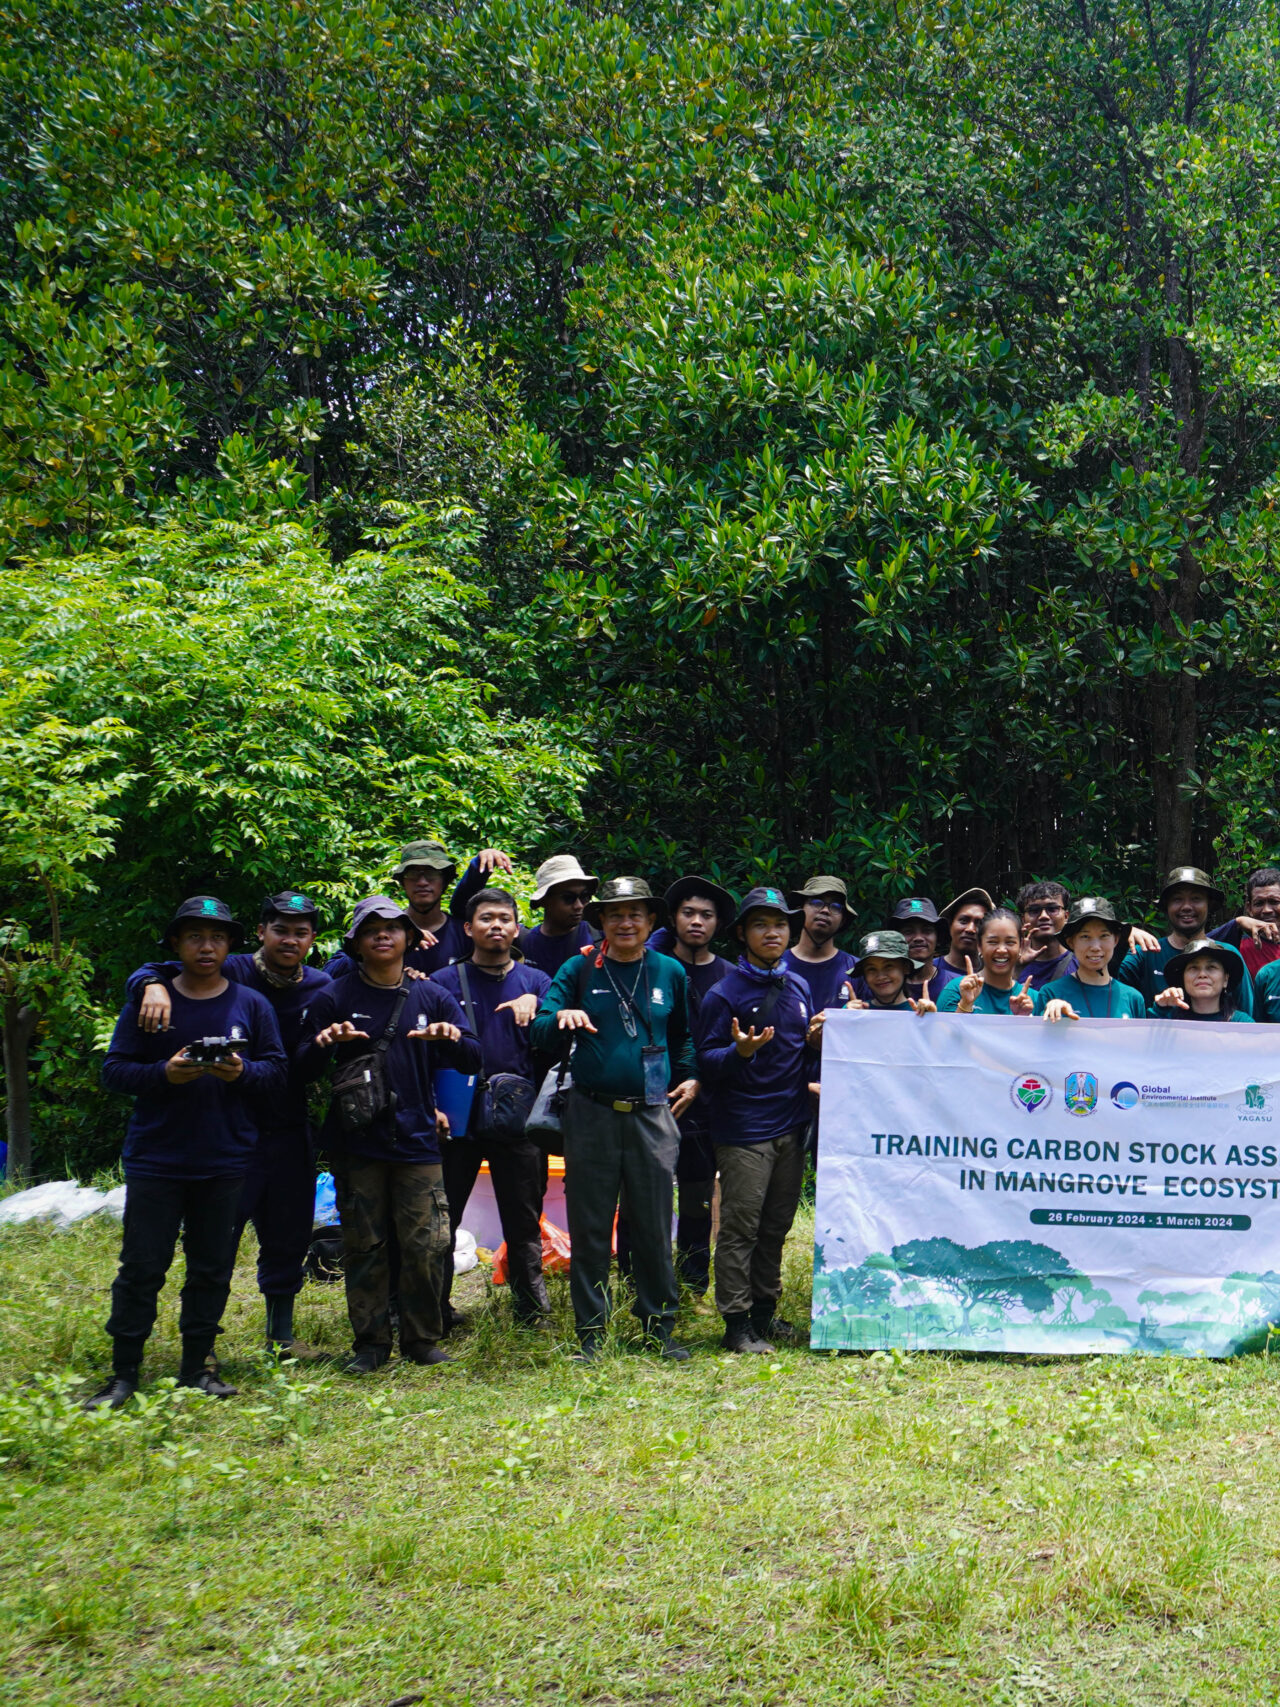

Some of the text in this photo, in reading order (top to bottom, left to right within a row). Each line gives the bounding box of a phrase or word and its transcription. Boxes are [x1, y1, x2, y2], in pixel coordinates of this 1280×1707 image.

[1141, 1085, 1171, 1094] Global
[871, 1134, 998, 1159] TRAINING
[1007, 1138, 1120, 1162] CARBON
[1128, 1142, 1217, 1165] STOCK
[960, 1169, 985, 1191] IN
[995, 1171, 1147, 1196] MANGROVE
[1048, 1212, 1063, 1222] 26
[1066, 1213, 1114, 1226] February
[1117, 1214, 1146, 1224] 2024
[1156, 1216, 1163, 1225] 1
[1167, 1216, 1201, 1226] March
[1204, 1217, 1233, 1227] 2024
